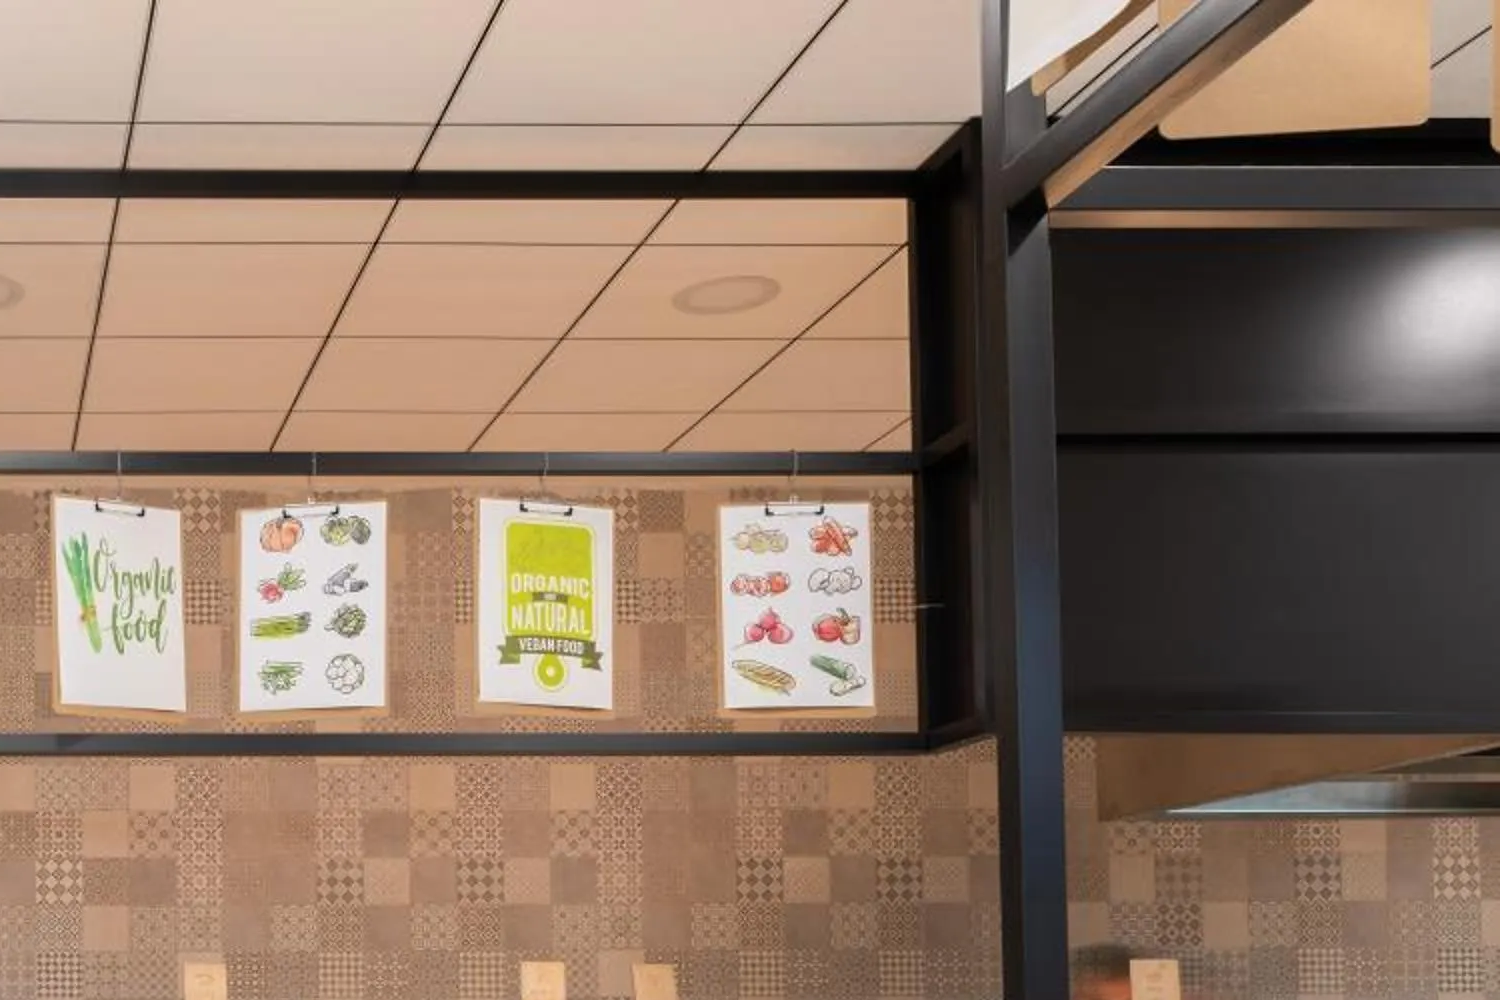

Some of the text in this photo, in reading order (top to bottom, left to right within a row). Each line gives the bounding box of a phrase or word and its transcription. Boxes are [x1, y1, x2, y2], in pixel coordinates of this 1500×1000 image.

[93, 536, 177, 619] Organic
[511, 573, 589, 598] ORGANIC
[103, 600, 168, 655] food
[511, 601, 590, 635] NATURAL
[518, 637, 585, 655] VEGAN FOOD
